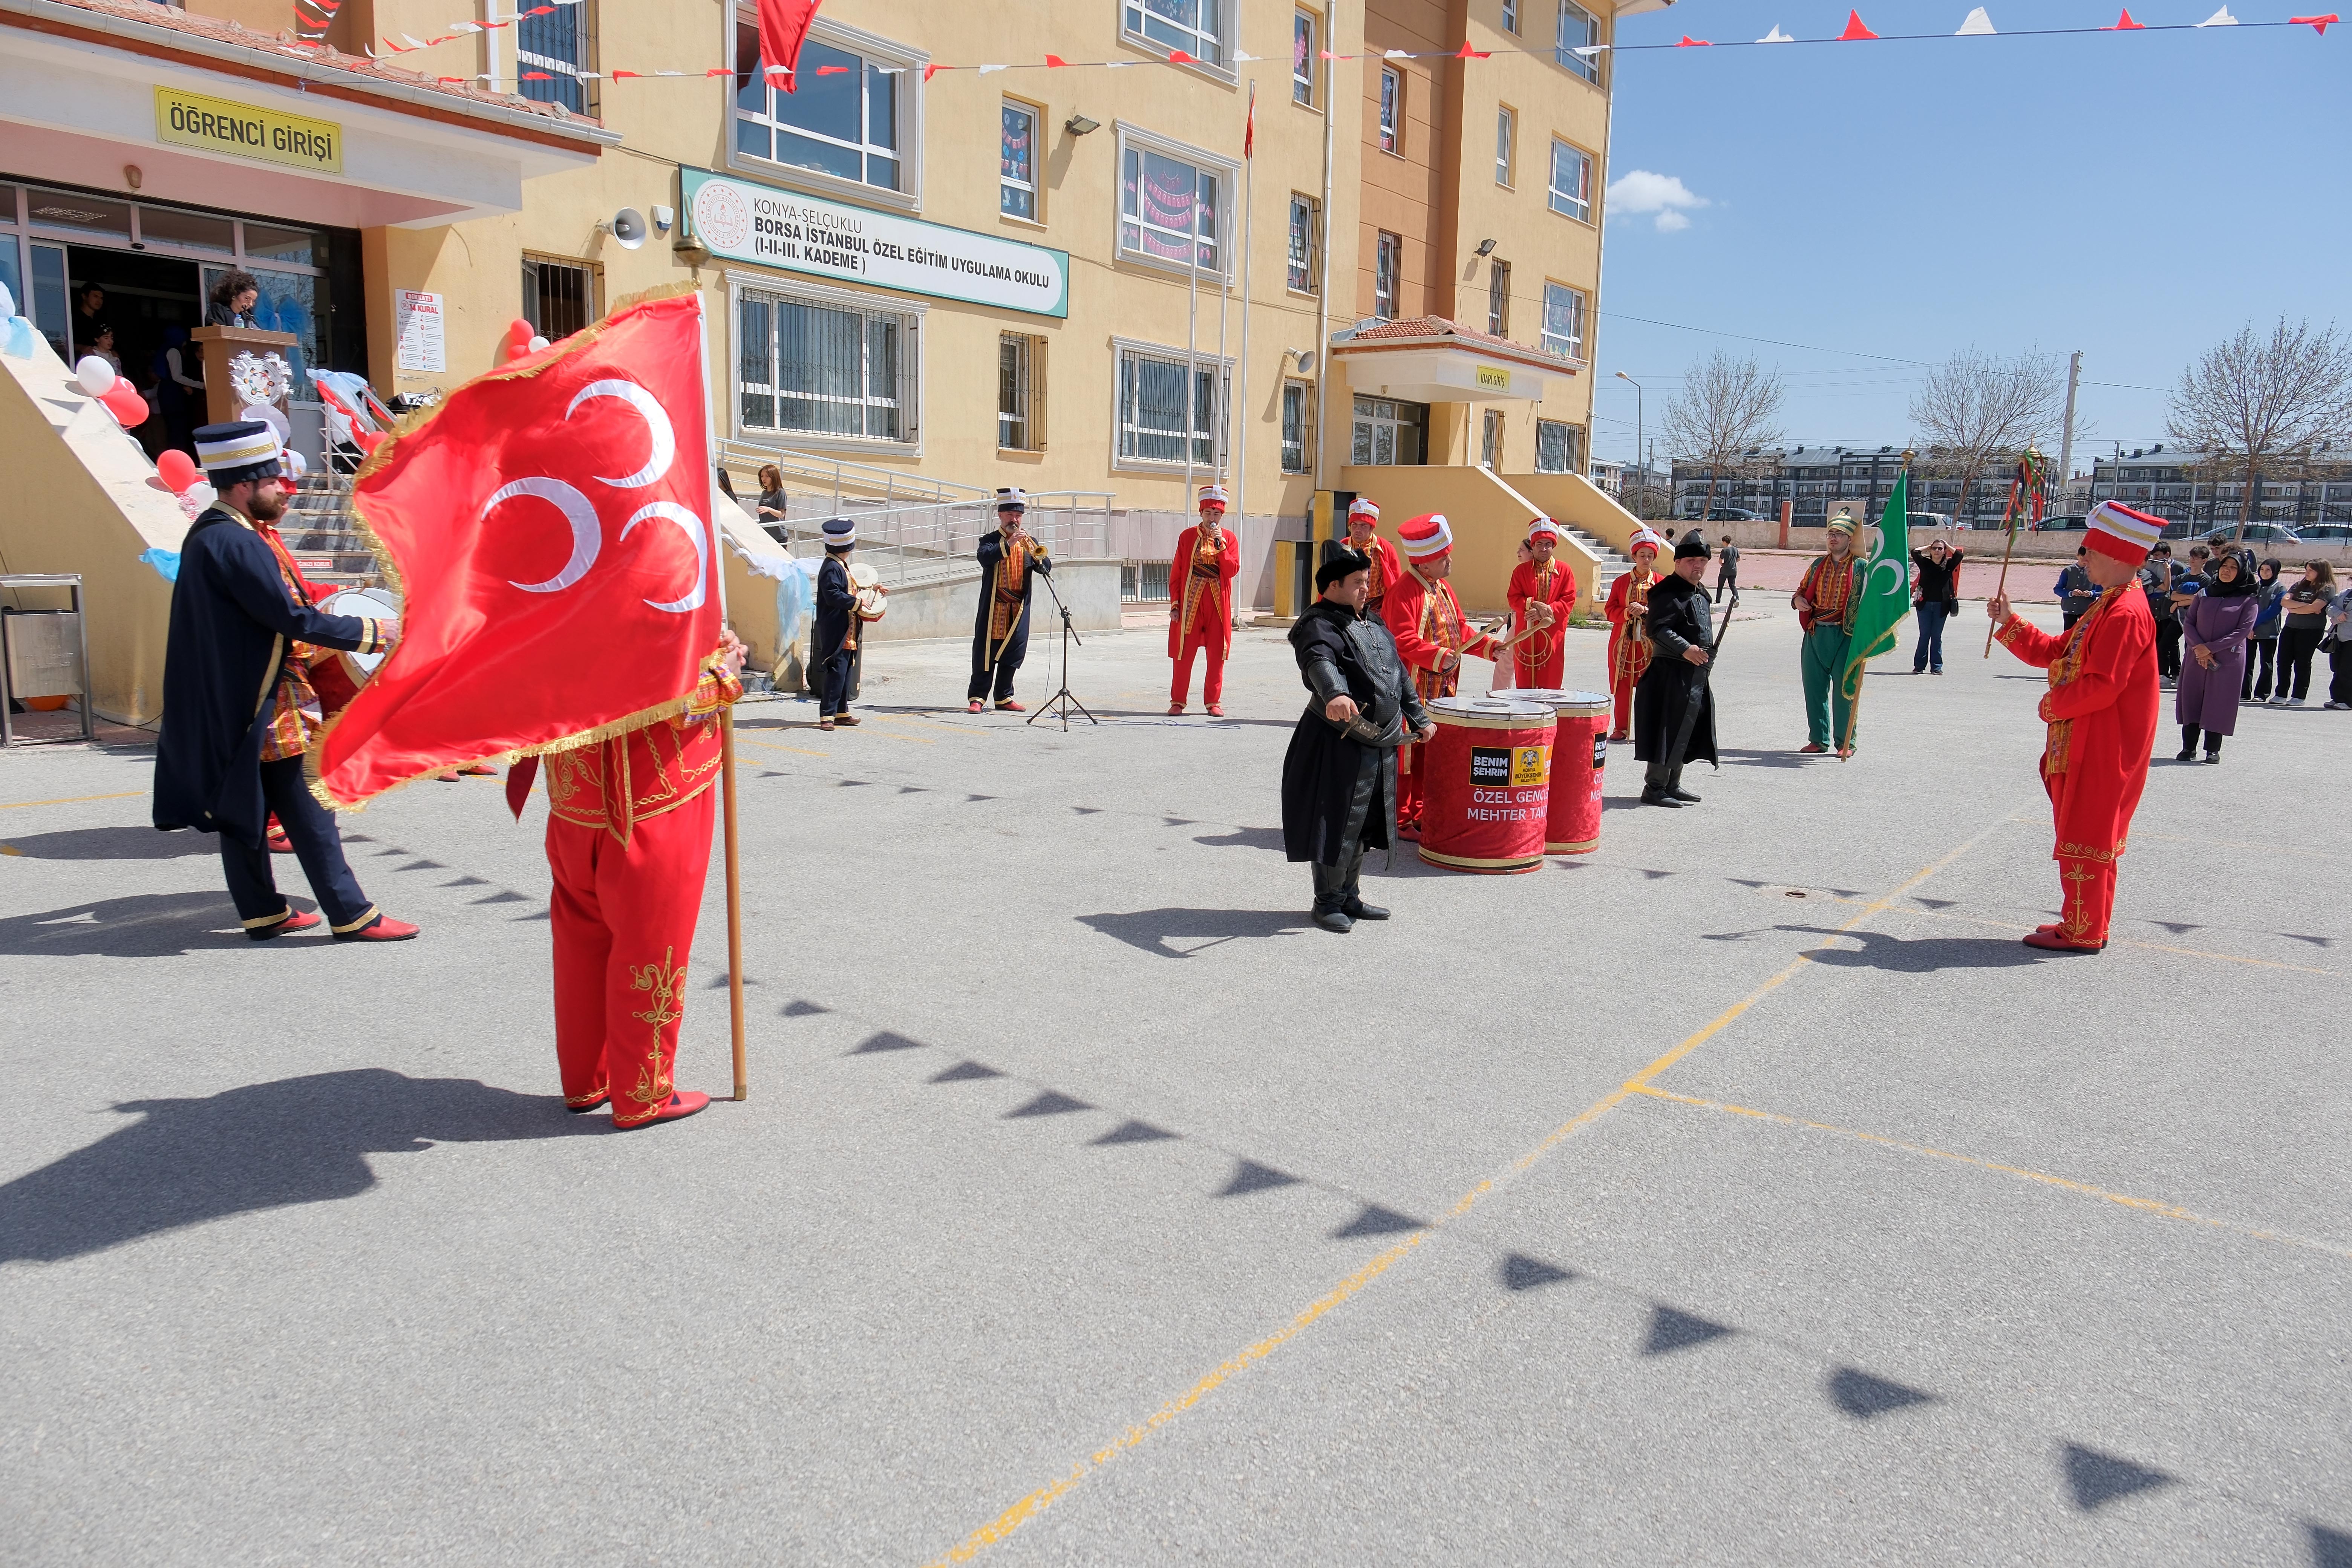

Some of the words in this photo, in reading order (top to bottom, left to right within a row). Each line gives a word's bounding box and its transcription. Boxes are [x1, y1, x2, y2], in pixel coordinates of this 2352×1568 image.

[171, 101, 265, 147] ÖĞRENCİ
[273, 125, 332, 162] GİRİŞİ
[754, 198, 862, 233] KONYA-SELÇUKLU
[755, 216, 802, 240] BORSA
[806, 223, 869, 254] İSTANBUL
[873, 238, 904, 260] ÖZEL
[908, 246, 948, 269] EĞİTİM
[951, 257, 1011, 282] UYGULAMA
[1014, 270, 1049, 288] OKULU
[755, 236, 799, 259] (I-II-III.
[804, 246, 858, 270] KADEME
[417, 305, 439, 314] KURAL
[1481, 371, 1493, 385] İDARİ
[1473, 767, 1507, 776] ŞEHRİM
[1473, 788, 1512, 803] ÖZEL
[1467, 808, 1526, 821] MEHTER
